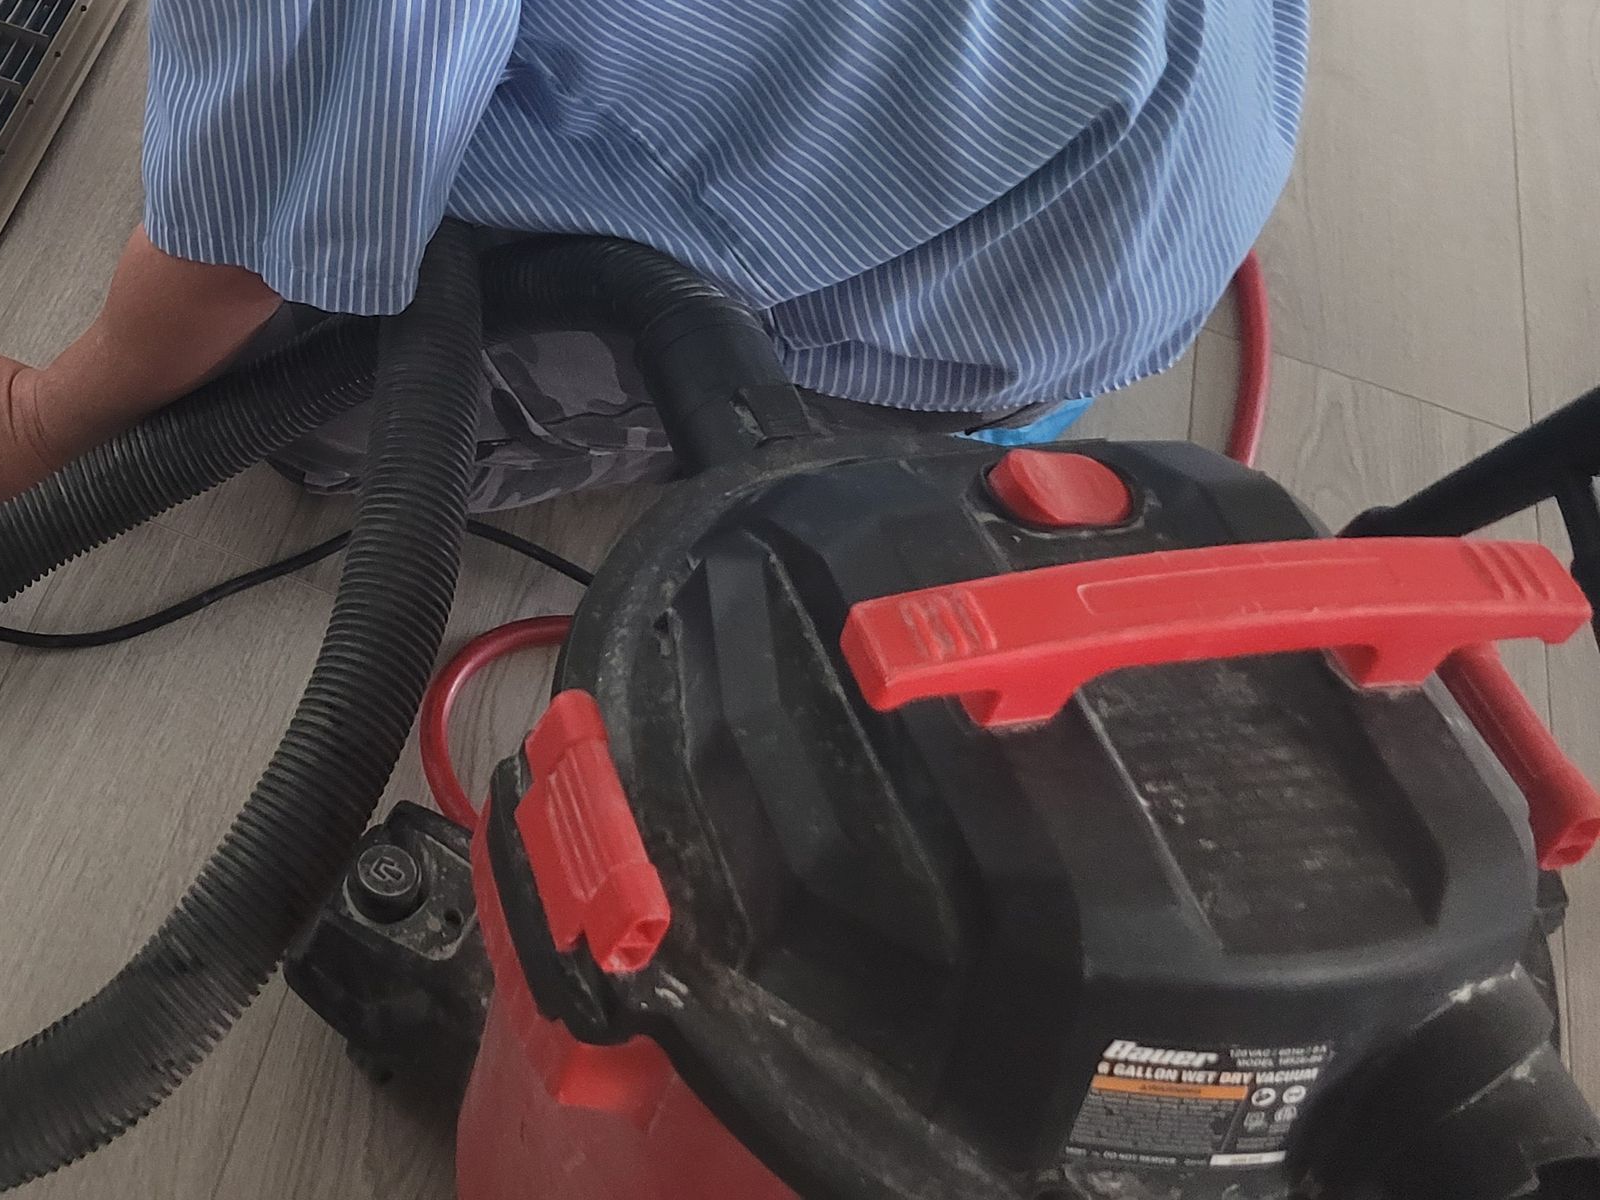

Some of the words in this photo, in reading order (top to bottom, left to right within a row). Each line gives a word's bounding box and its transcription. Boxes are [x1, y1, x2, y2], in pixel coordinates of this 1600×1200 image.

[1102, 1040, 1219, 1068] Bauer
[1113, 1062, 1179, 1082] GALLON
[1181, 1069, 1219, 1084] WET
[1219, 1071, 1255, 1084] DRY
[1256, 1067, 1319, 1085] VACUUM
